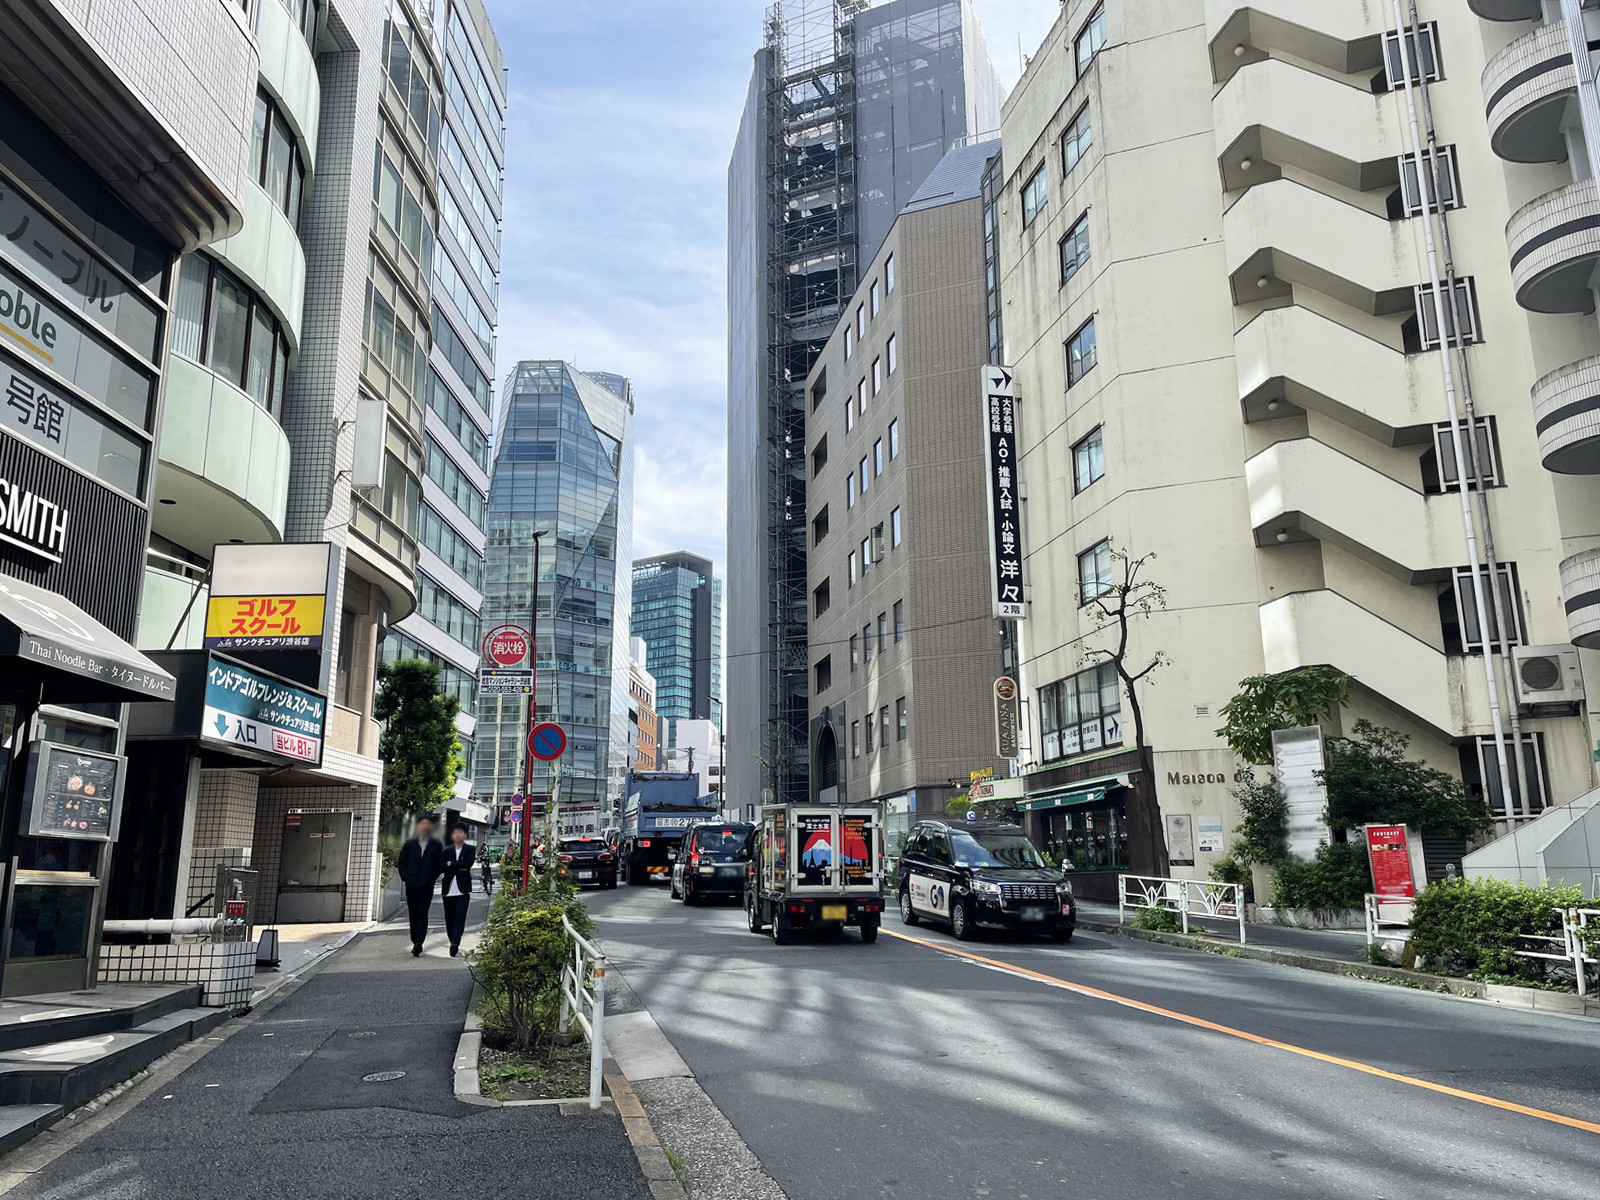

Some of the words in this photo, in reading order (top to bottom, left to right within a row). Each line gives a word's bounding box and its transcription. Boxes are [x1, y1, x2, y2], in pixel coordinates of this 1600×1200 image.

[0, 191, 113, 313] ノーブル
[0, 288, 57, 349] oble
[6, 374, 65, 444] 号館
[990, 397, 1001, 433] 高校受験
[1002, 398, 1013, 434] 大学受験
[0, 477, 69, 554] SMITH
[1000, 559, 1020, 602] 洋々
[237, 598, 297, 617] ゴルフ
[1003, 605, 1021, 615] 2階
[229, 617, 302, 635] スクール
[30, 640, 52, 659] Thai
[54, 649, 86, 669] Noodle
[88, 657, 103, 673] Bar
[235, 637, 310, 647] サンクチュアリ渋谷店
[493, 641, 524, 655] 消火栓
[111, 665, 171, 692] タイヌードルバー
[209, 666, 322, 719] インドアゴルフレンジ&スクール
[235, 720, 257, 745] 入口
[270, 709, 321, 735] サンクチュアリ渋谷店
[1167, 771, 1226, 785] Maison
